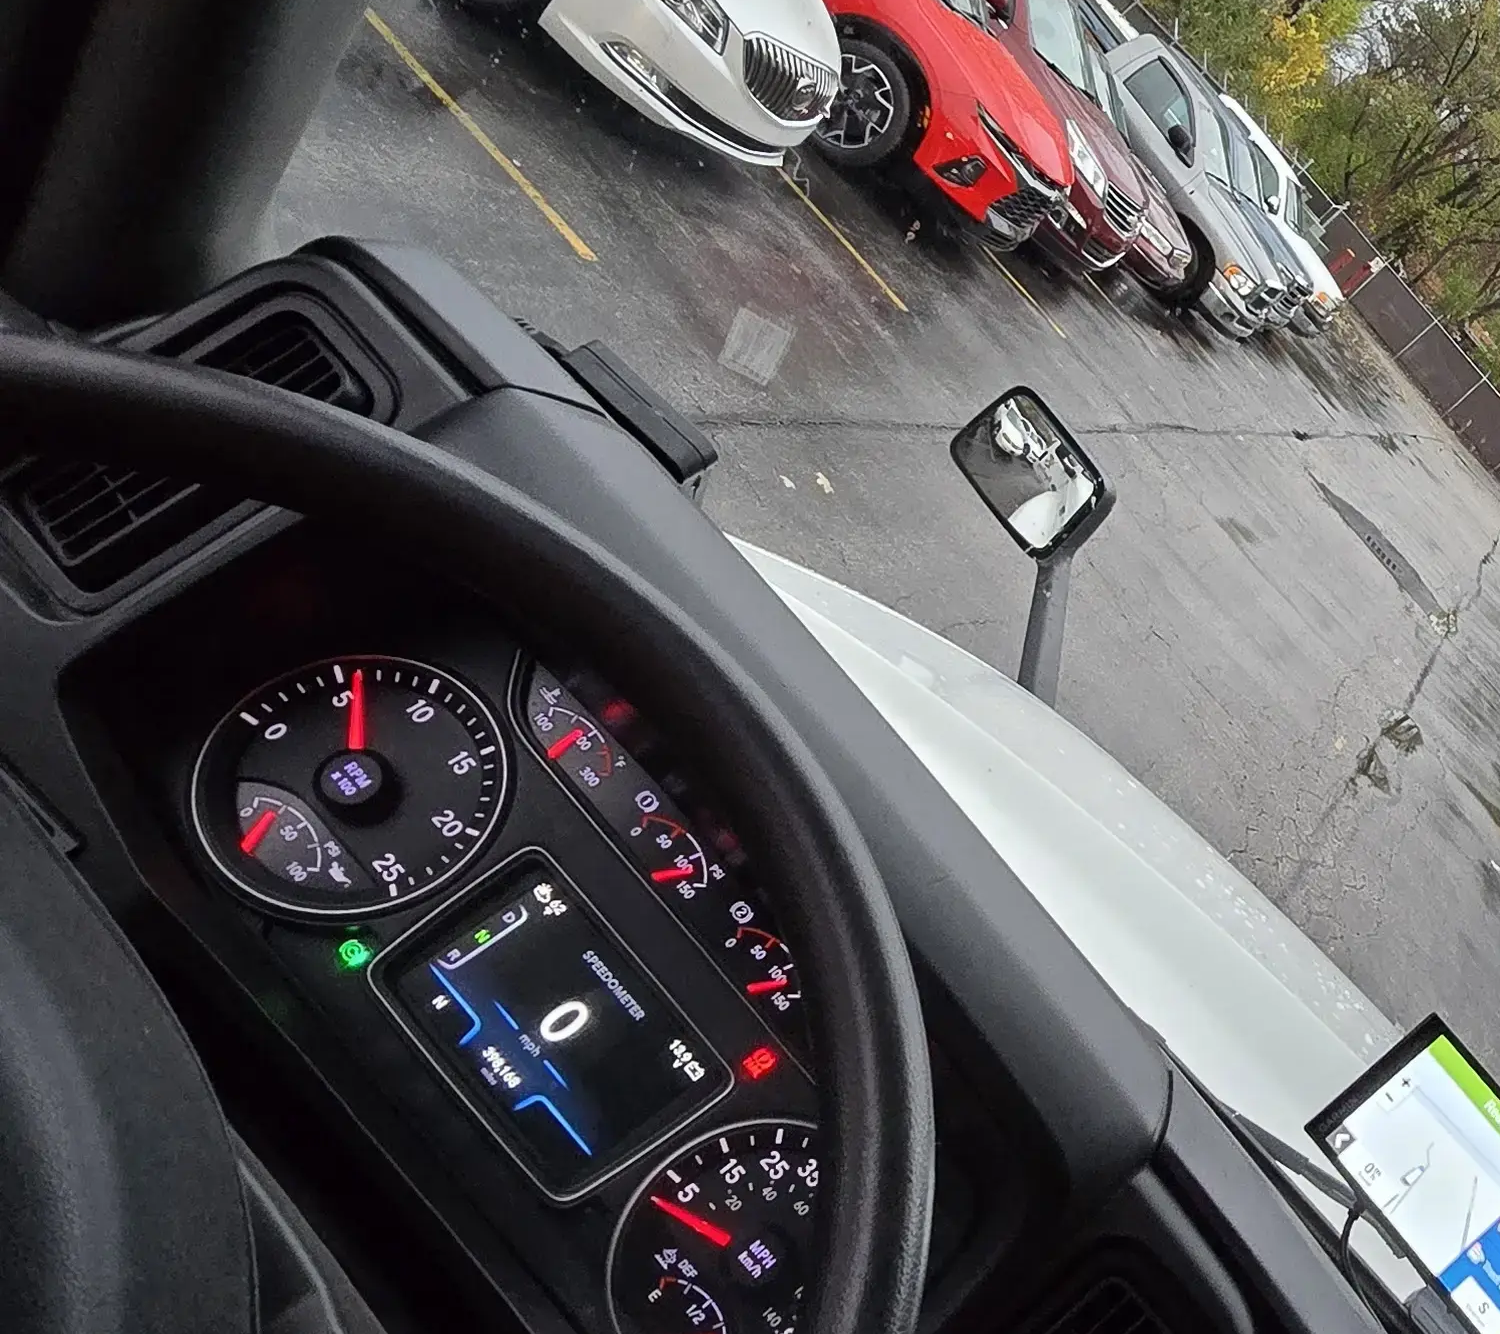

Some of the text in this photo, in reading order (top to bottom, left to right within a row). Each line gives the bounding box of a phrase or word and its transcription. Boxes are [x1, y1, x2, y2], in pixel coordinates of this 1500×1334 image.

[332, 690, 354, 708] 5
[405, 699, 435, 724] 10
[264, 723, 287, 740] 0
[533, 712, 553, 732] 100
[447, 751, 477, 775] 15
[343, 761, 372, 789] RPM
[578, 766, 600, 788] 300
[338, 776, 357, 796] 100
[239, 807, 254, 818] 0
[279, 824, 298, 842] 50
[431, 809, 463, 837] 20
[630, 826, 643, 837] 0
[323, 840, 341, 858] PSI
[655, 833, 673, 850] 50
[286, 861, 307, 882] 100
[372, 853, 405, 882] 25
[708, 864, 726, 880] PSI
[676, 880, 696, 900] 150
[502, 911, 516, 924] D
[474, 929, 491, 944] N
[725, 937, 738, 949] 0
[447, 948, 462, 962] R
[750, 944, 767, 961] 50
[582, 949, 646, 1022] SPEEDOMETER
[431, 995, 450, 1011] N
[770, 991, 791, 1012] 150
[540, 1000, 589, 1042] 0
[518, 1033, 541, 1058] mph
[719, 1158, 746, 1184] 15
[759, 1150, 790, 1180] 25
[677, 1182, 700, 1203] 5
[761, 1186, 778, 1202] 40
[725, 1194, 743, 1212] 20
[793, 1200, 810, 1216] 60
[749, 1239, 777, 1269] MPH
[677, 1259, 699, 1279] DEF
[737, 1250, 763, 1279] km/h
[648, 1288, 662, 1303] E
[685, 1304, 706, 1326] 1/2
[762, 1306, 782, 1328] 140
[1478, 1302, 1490, 1315] S
